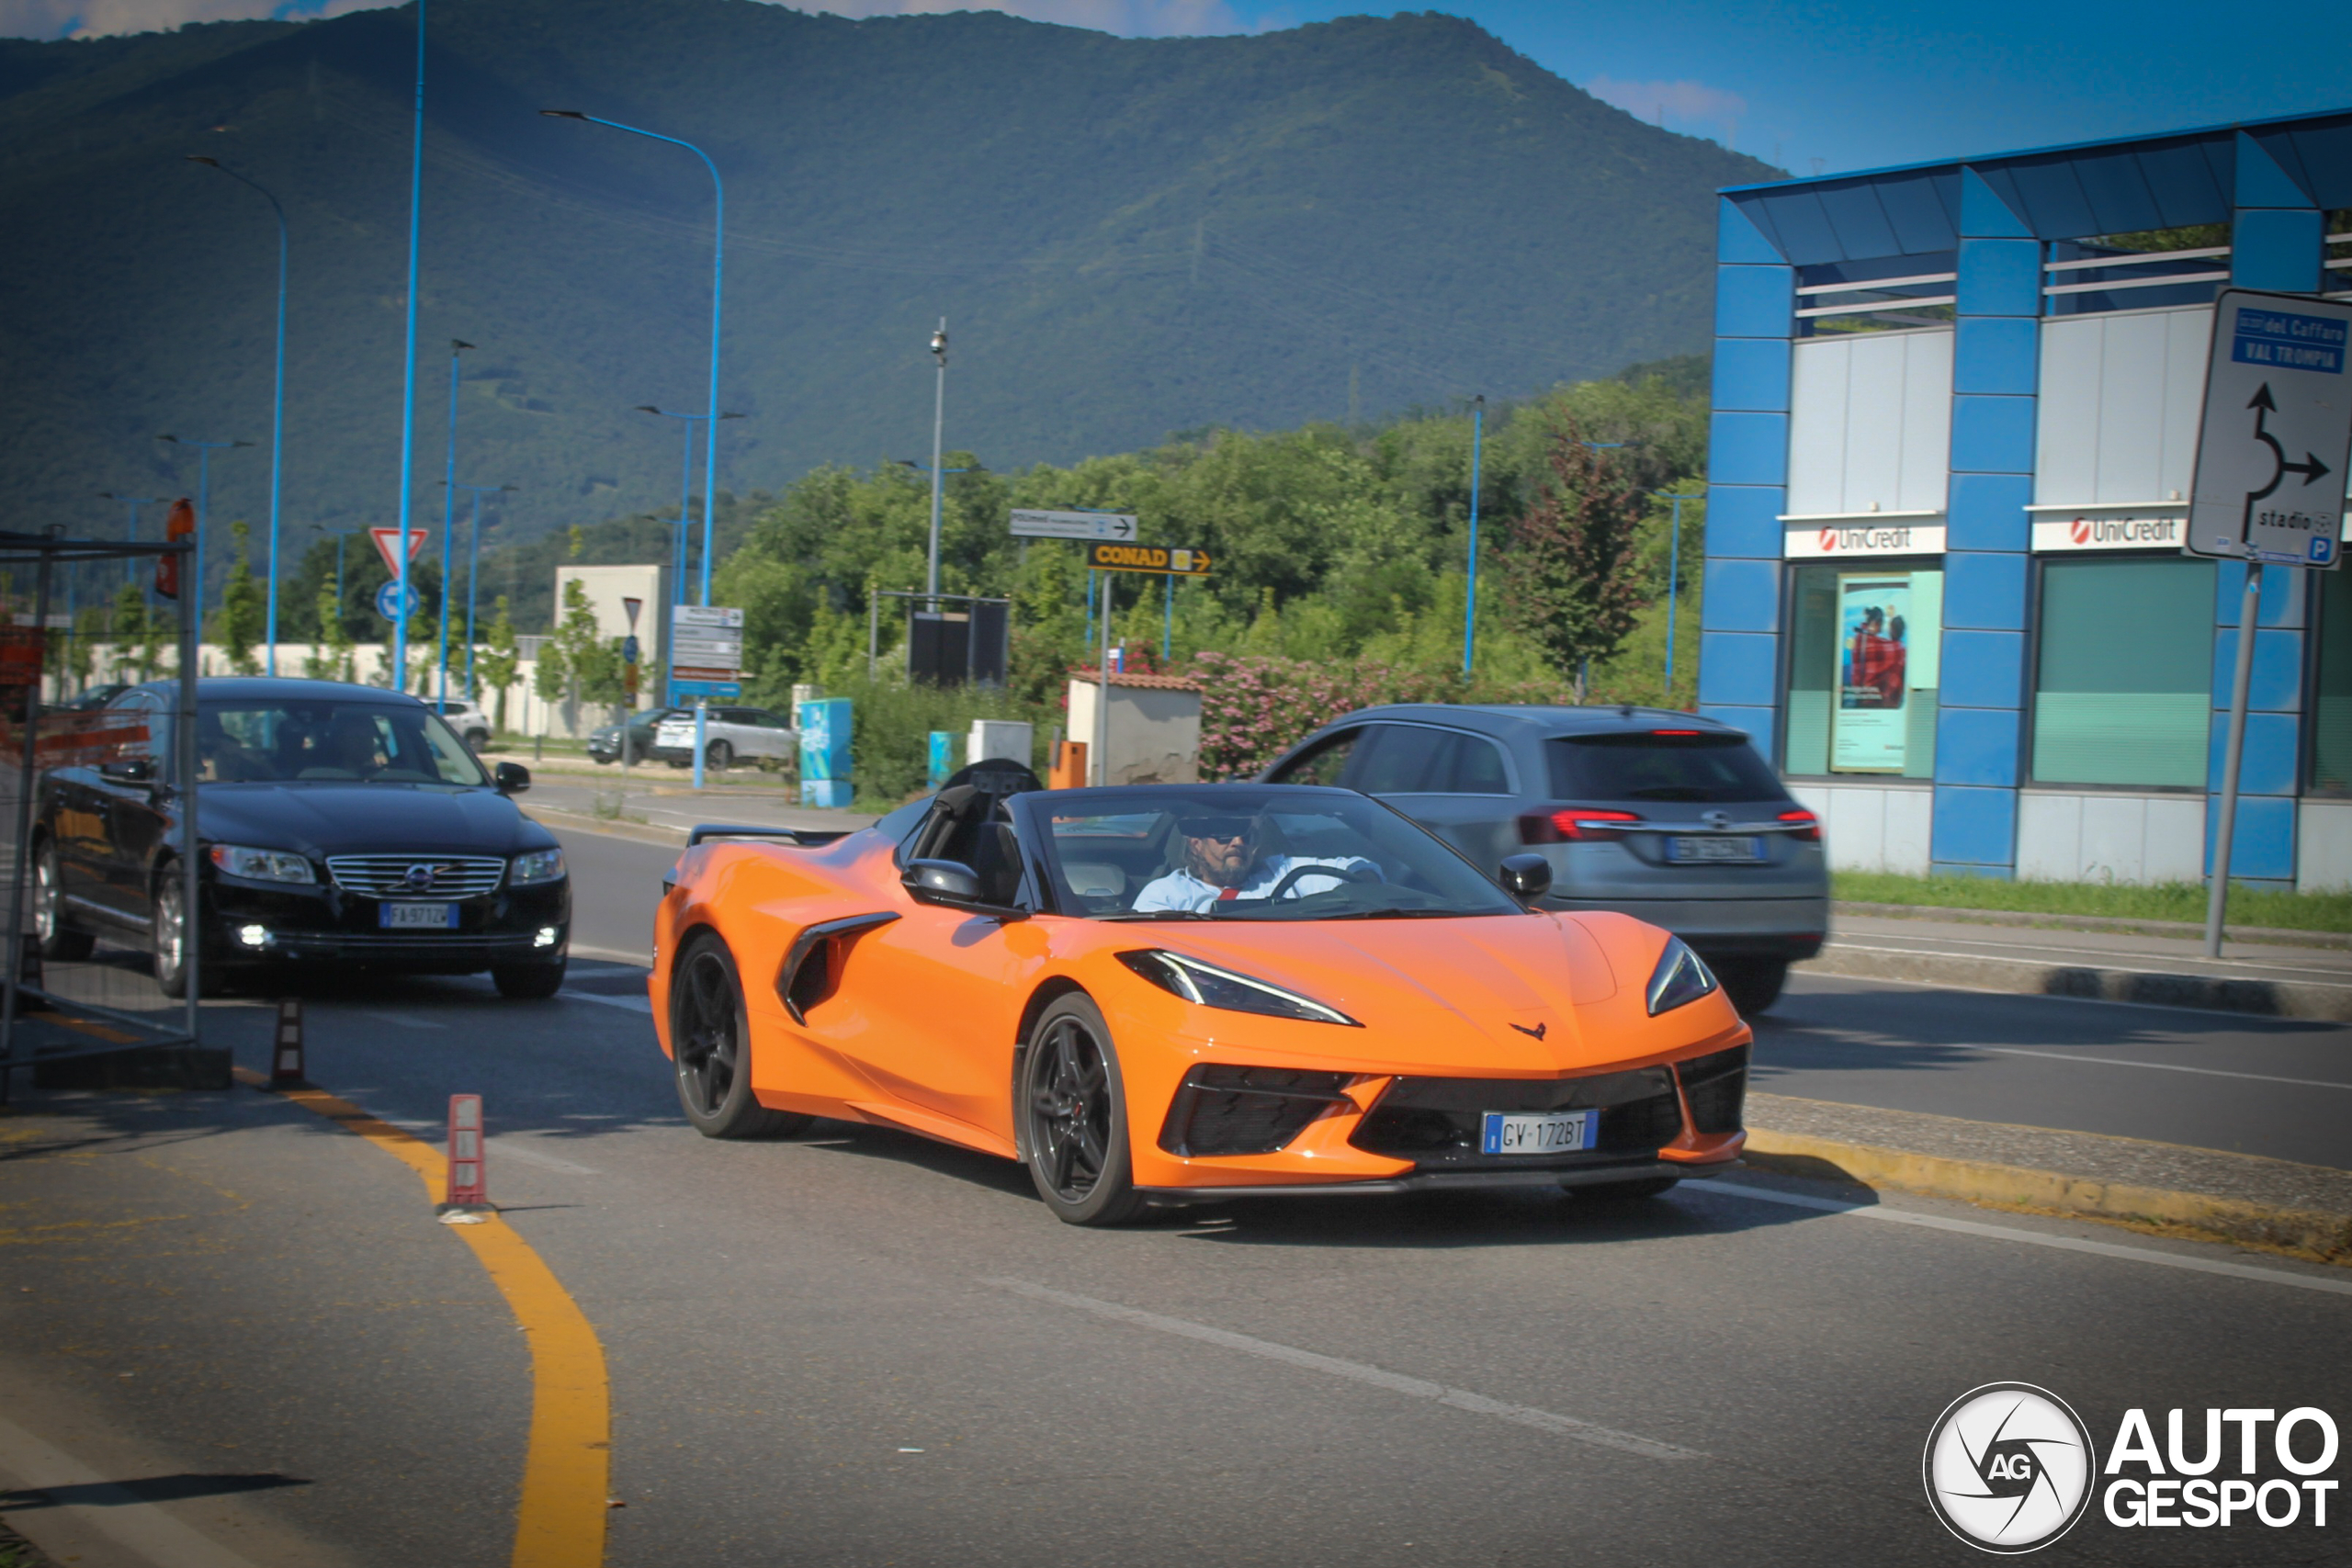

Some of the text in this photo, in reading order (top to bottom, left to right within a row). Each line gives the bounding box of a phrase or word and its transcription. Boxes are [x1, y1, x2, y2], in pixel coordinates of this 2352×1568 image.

[2265, 318, 2288, 334] del
[2291, 319, 2345, 341] Caffaro
[2245, 342, 2336, 368] VAL TROMPIA
[2093, 516, 2177, 542] UniCredit
[2258, 509, 2312, 531] stadio
[1838, 525, 1911, 549] UniCredit
[1095, 545, 1169, 568] CONAD
[2313, 540, 2329, 558] P
